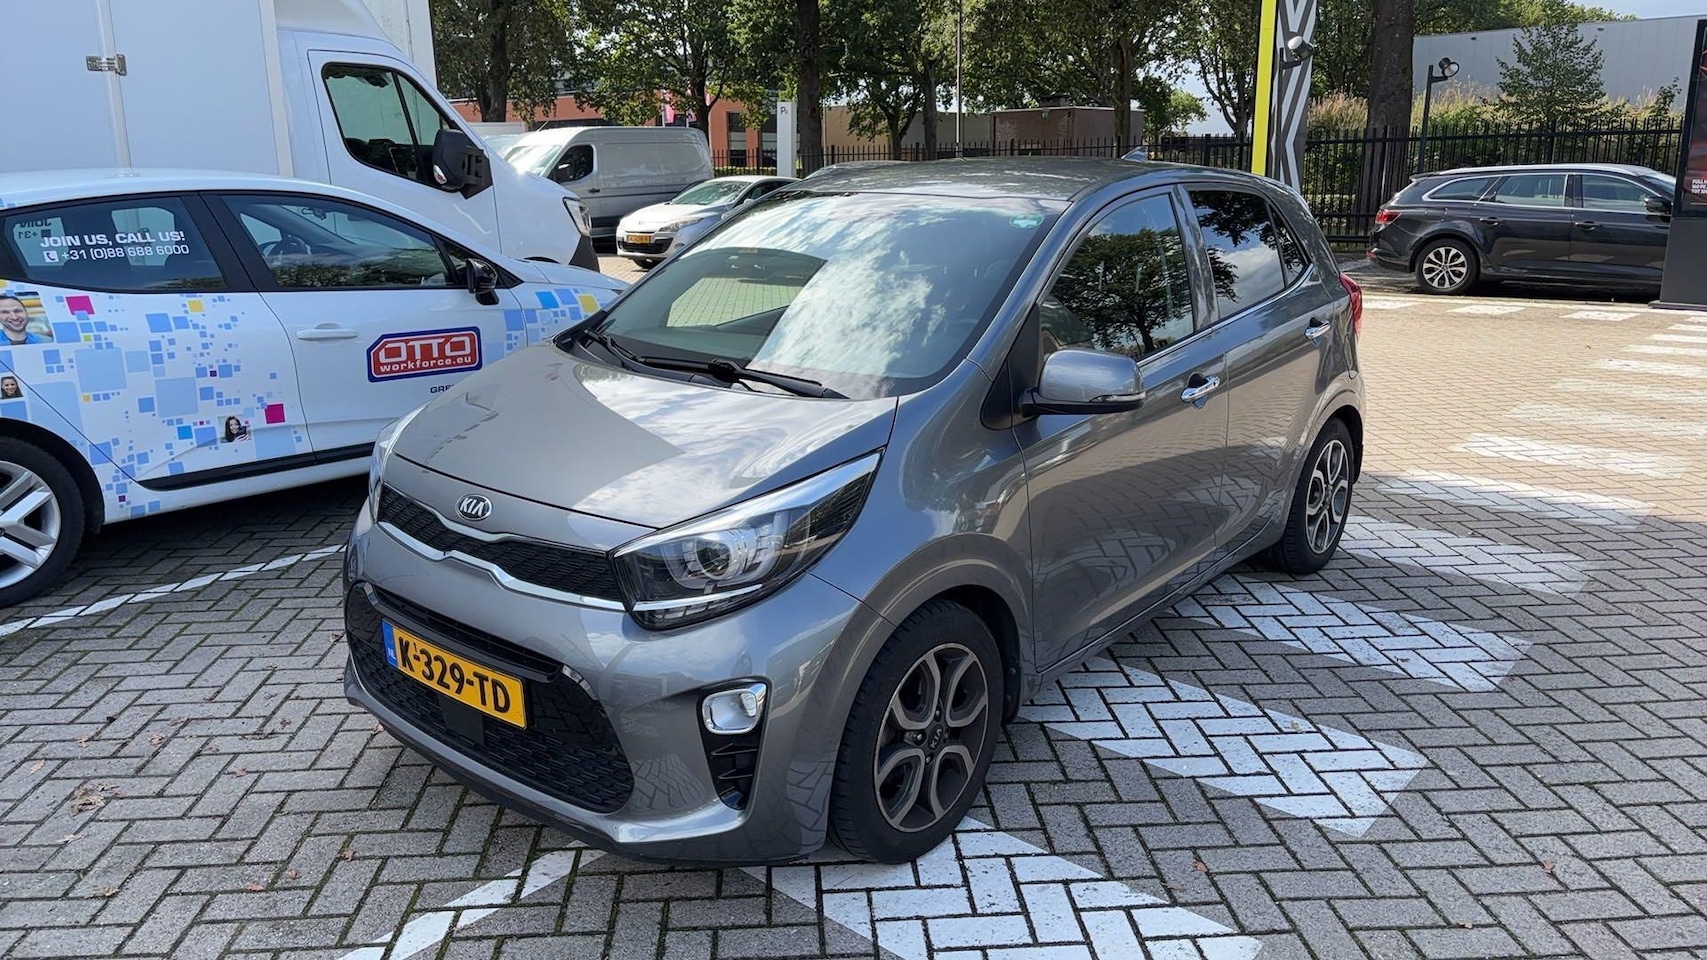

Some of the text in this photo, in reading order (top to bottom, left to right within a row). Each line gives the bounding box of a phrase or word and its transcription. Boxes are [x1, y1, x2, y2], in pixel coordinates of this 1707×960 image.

[40, 230, 186, 248] JOIN US, CALL US!
[61, 244, 190, 261] +31 (0)88 688 6000
[379, 336, 471, 364] OTTO
[380, 356, 472, 373] workforce.eu
[459, 497, 485, 517] KIA
[387, 647, 397, 660] NL
[398, 636, 511, 714] K-329-TD
[930, 728, 942, 749] KIA
